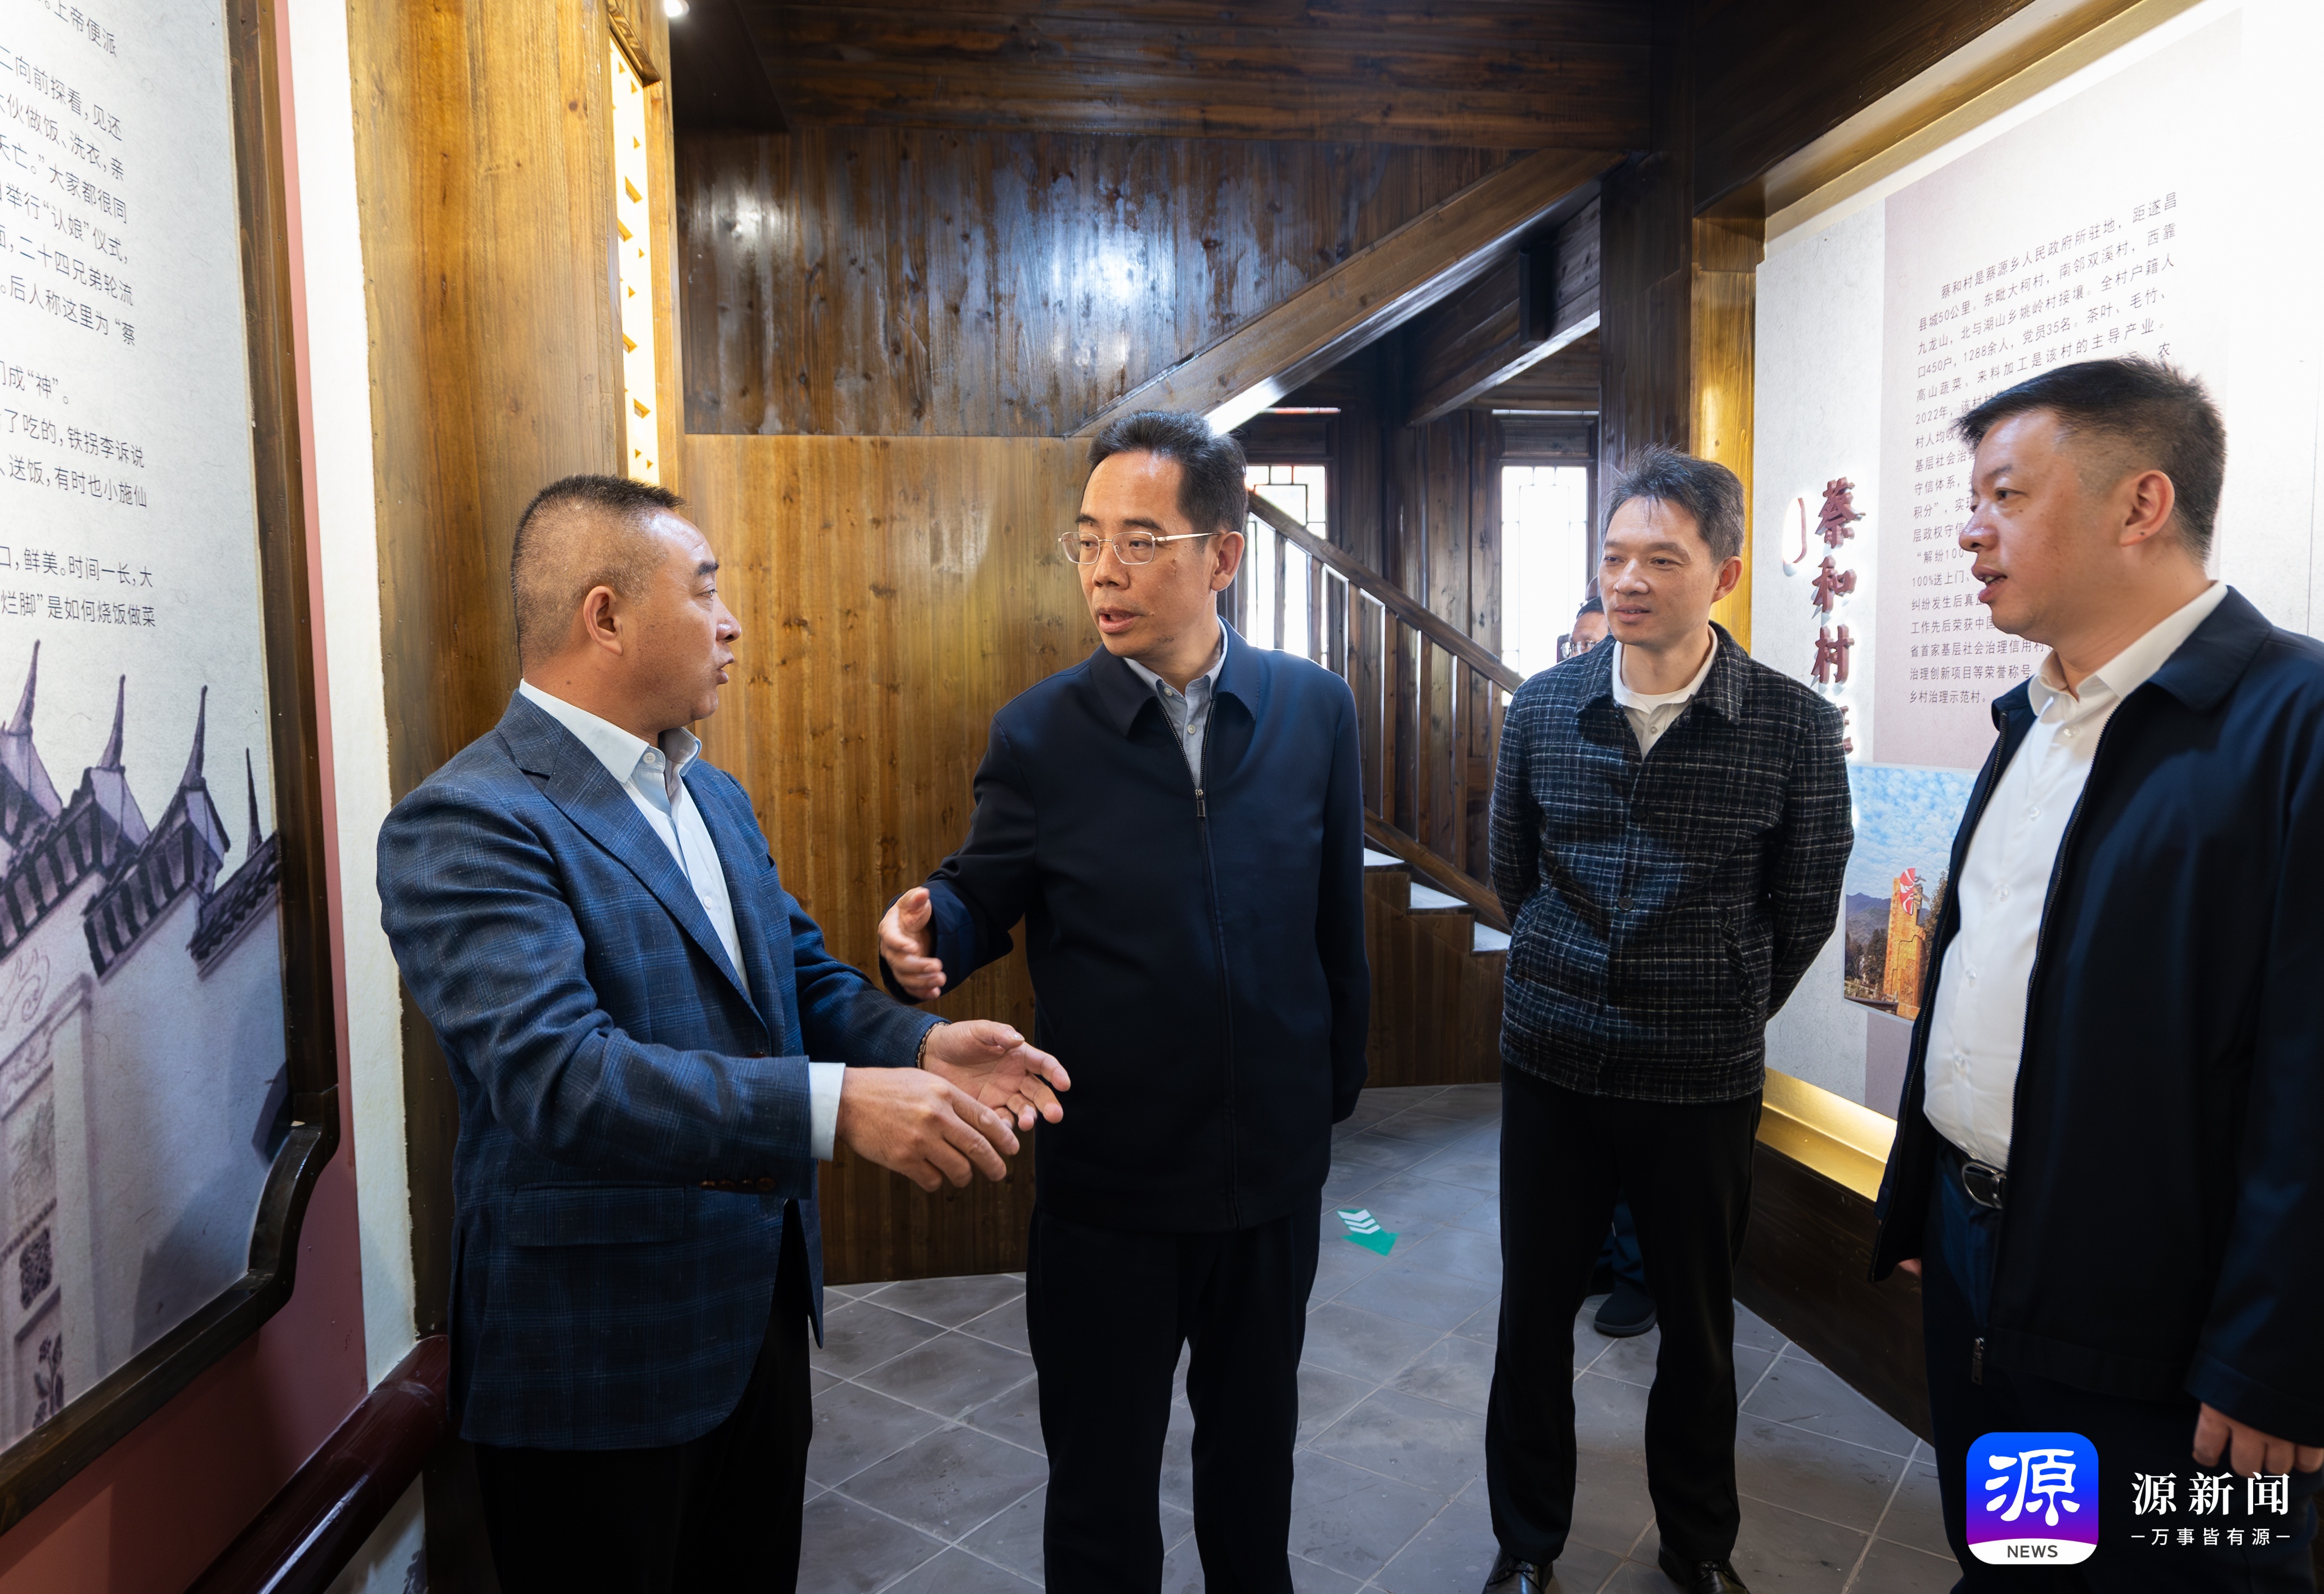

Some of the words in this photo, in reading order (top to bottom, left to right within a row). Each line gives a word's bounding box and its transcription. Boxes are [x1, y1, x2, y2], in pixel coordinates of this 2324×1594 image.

[0, 181, 127, 264] 举行“认娘”仪式，
[0, 454, 147, 508] 送饭，有时也小施仙
[1914, 472, 1972, 496] 守信体系，
[1, 589, 156, 627] 烂脚”是如何烧饭做菜
[1811, 476, 1866, 755] 蔡和村
[1909, 664, 2031, 680] 治理创新项目等荣誉称号
[1909, 689, 1986, 704] 乡村治理示范村。
